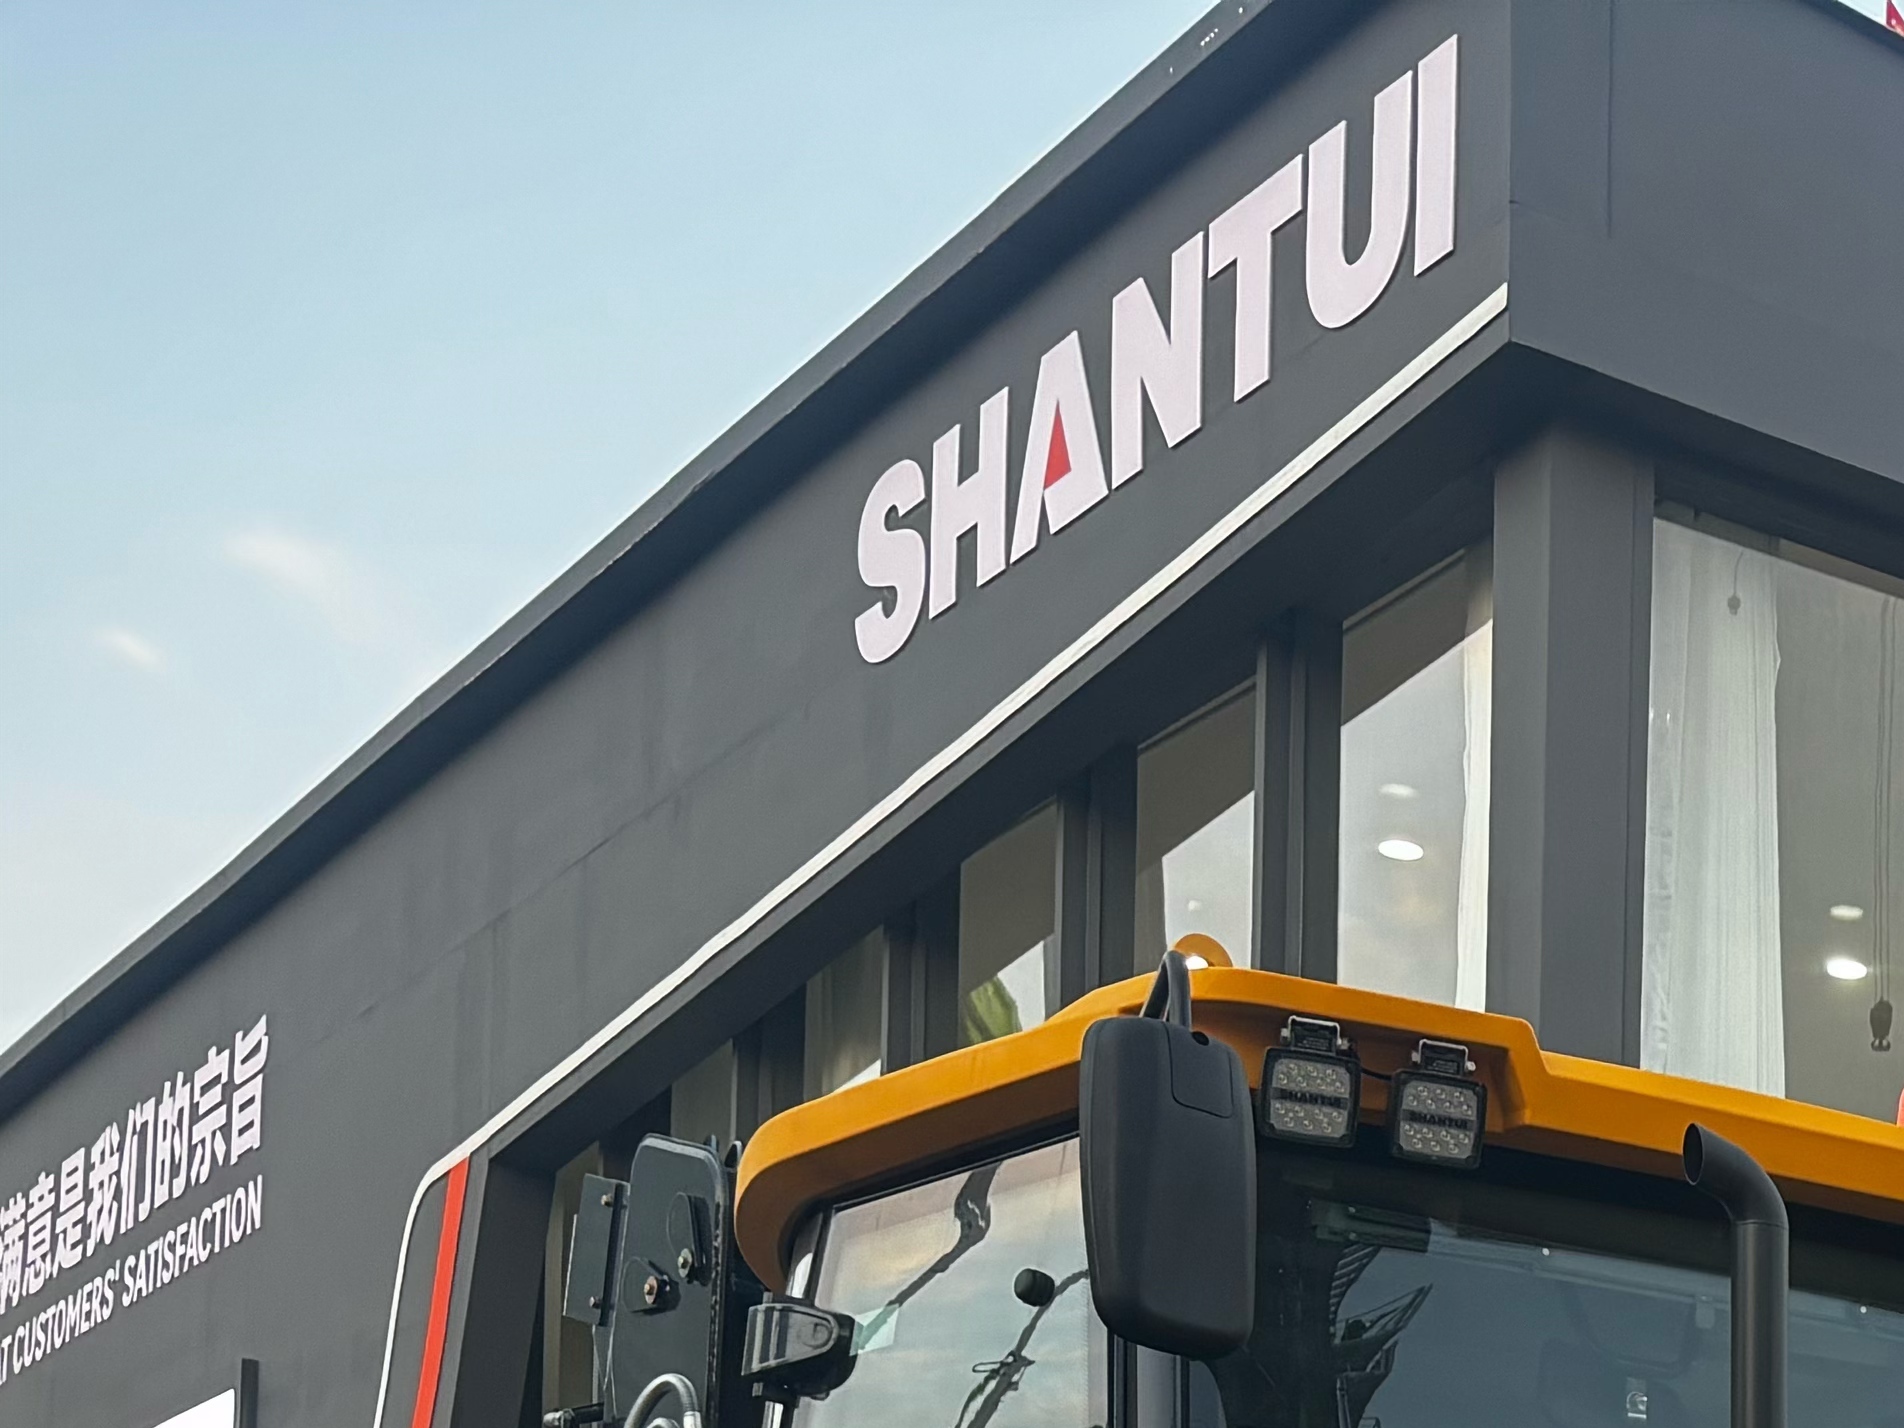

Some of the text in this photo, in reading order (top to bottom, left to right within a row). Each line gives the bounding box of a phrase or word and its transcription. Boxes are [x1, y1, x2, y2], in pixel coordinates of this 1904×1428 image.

[854, 34, 1458, 665] SHANTUI
[13, 1259, 120, 1375] CUSTOMERS'
[122, 1175, 262, 1308] SATISFACTION
